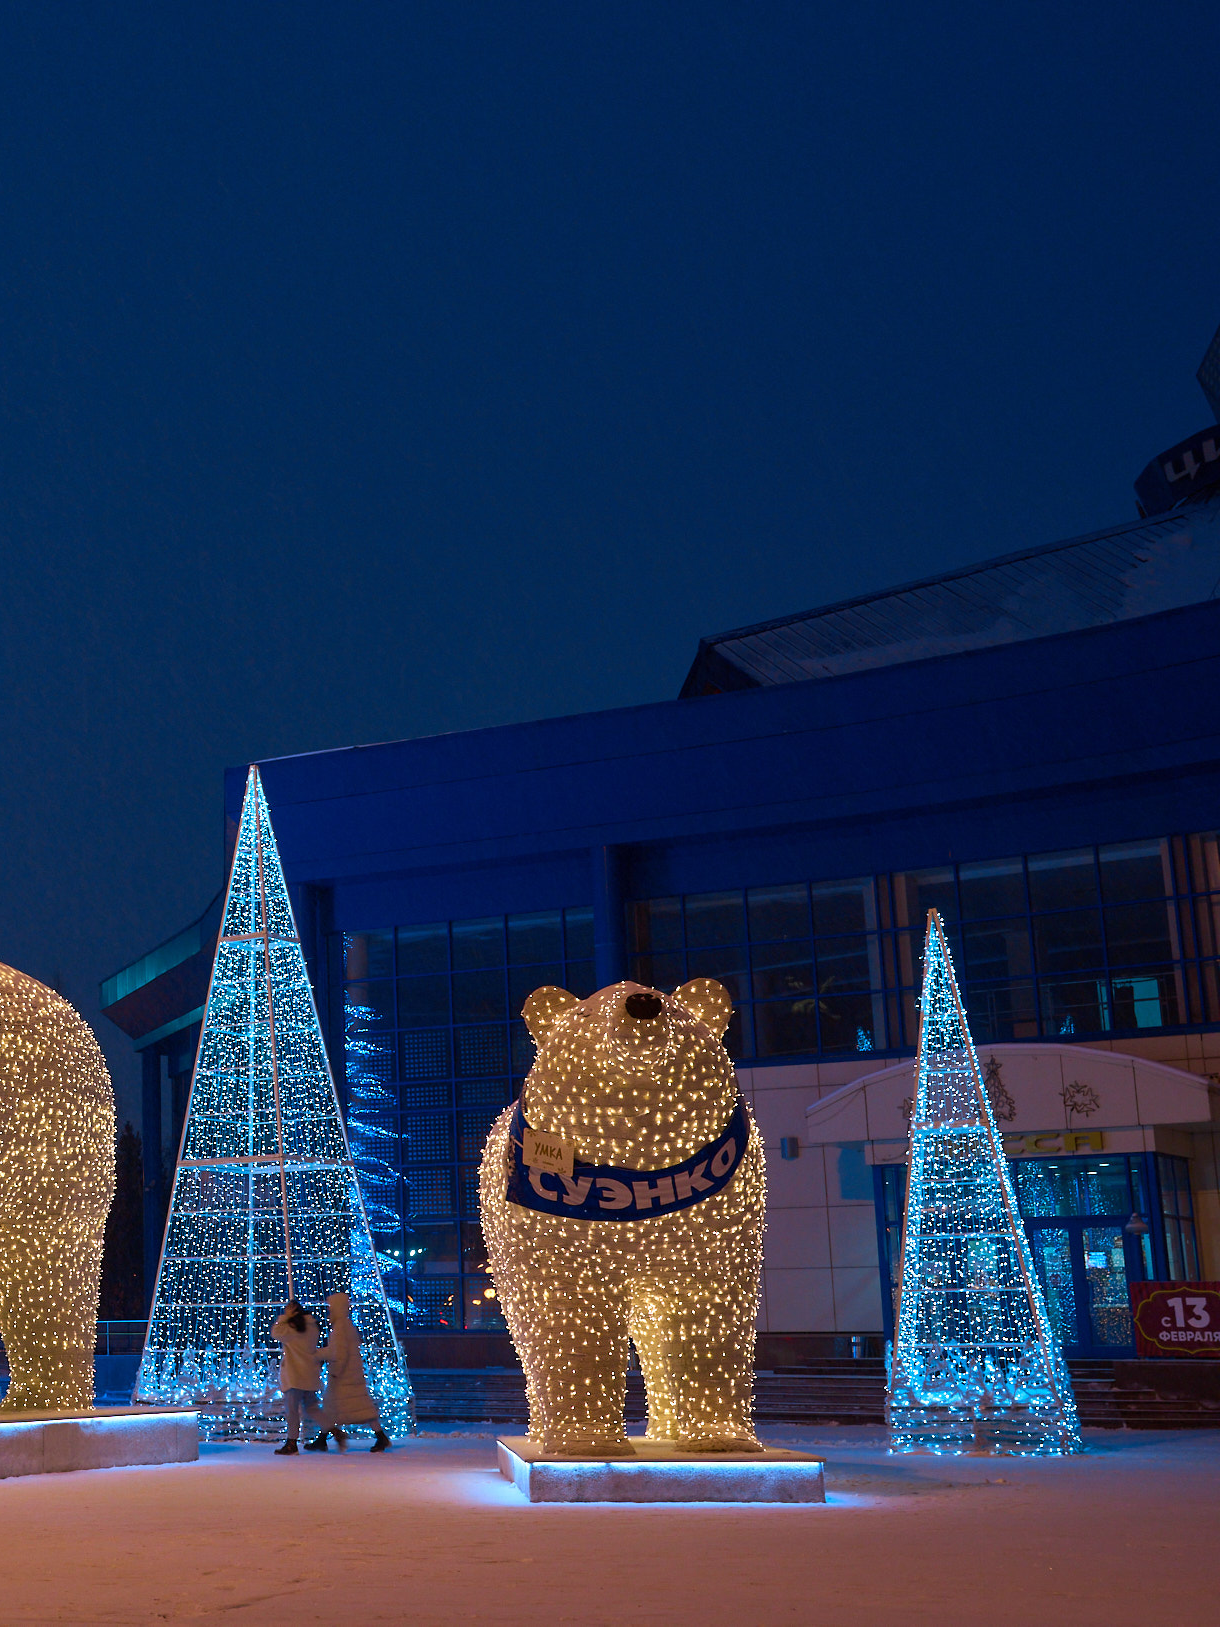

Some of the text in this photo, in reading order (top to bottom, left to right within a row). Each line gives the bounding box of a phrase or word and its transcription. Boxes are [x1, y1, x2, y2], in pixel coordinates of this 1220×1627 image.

[534, 1142, 563, 1160] УМКА
[528, 1137, 737, 1210] СУЭНКО
[1166, 1297, 1211, 1328] 13
[1159, 1330, 1220, 1342] ФЕВРАЛЯ
